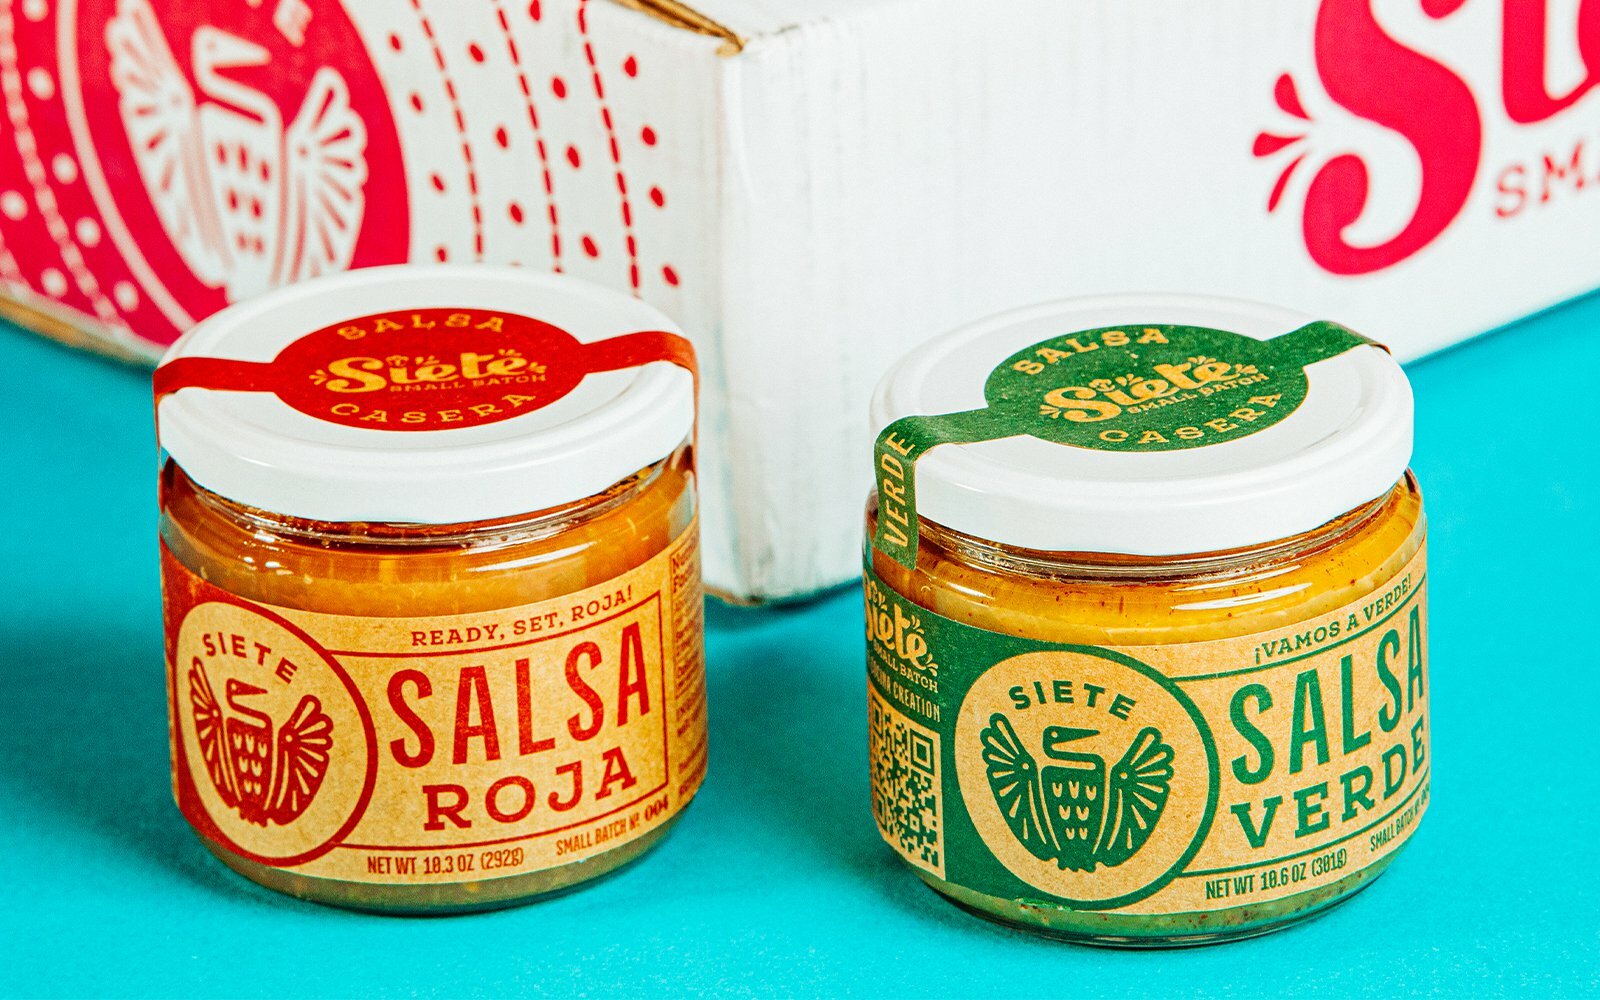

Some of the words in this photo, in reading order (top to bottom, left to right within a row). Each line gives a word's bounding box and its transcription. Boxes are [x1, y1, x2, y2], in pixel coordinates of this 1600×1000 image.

[1495, 140, 1600, 218] SM
[337, 313, 504, 341] SALSA
[1013, 328, 1169, 376] SALSA
[326, 350, 530, 393] Siete
[390, 382, 465, 392] SMALL
[473, 374, 547, 387] BATCH
[1044, 360, 1241, 423] Siete
[1127, 392, 1198, 414] SMALL
[1198, 373, 1269, 397] BATCH
[331, 393, 536, 424] CASERA
[1099, 392, 1283, 444] CASERA
[881, 431, 916, 548] VERDE
[411, 624, 505, 647] READY,
[513, 612, 564, 635] SET,
[571, 585, 633, 622] ROJA!
[1254, 620, 1341, 664] ¡VAMOS
[1346, 613, 1360, 632] A
[1363, 573, 1412, 622] VERDE!
[202, 632, 298, 684] SIETE
[900, 663, 939, 694] BATCH
[387, 621, 650, 769] SALSA
[893, 681, 941, 723] CREATION
[1008, 679, 1137, 722] SIETE
[1229, 603, 1425, 785] SALSA
[422, 746, 637, 832] ROJA
[1230, 714, 1426, 849] VERDE
[556, 831, 593, 856] SMALL
[595, 818, 627, 845] BATCH
[643, 793, 669, 822] 004
[1370, 823, 1395, 852] SMALL
[367, 856, 392, 875] NET
[395, 856, 417, 875] WT
[457, 853, 475, 873] OZ
[480, 846, 525, 870] (292g)
[1205, 878, 1231, 900] NET
[1233, 875, 1256, 895] WT
[1291, 862, 1307, 882] OZ
